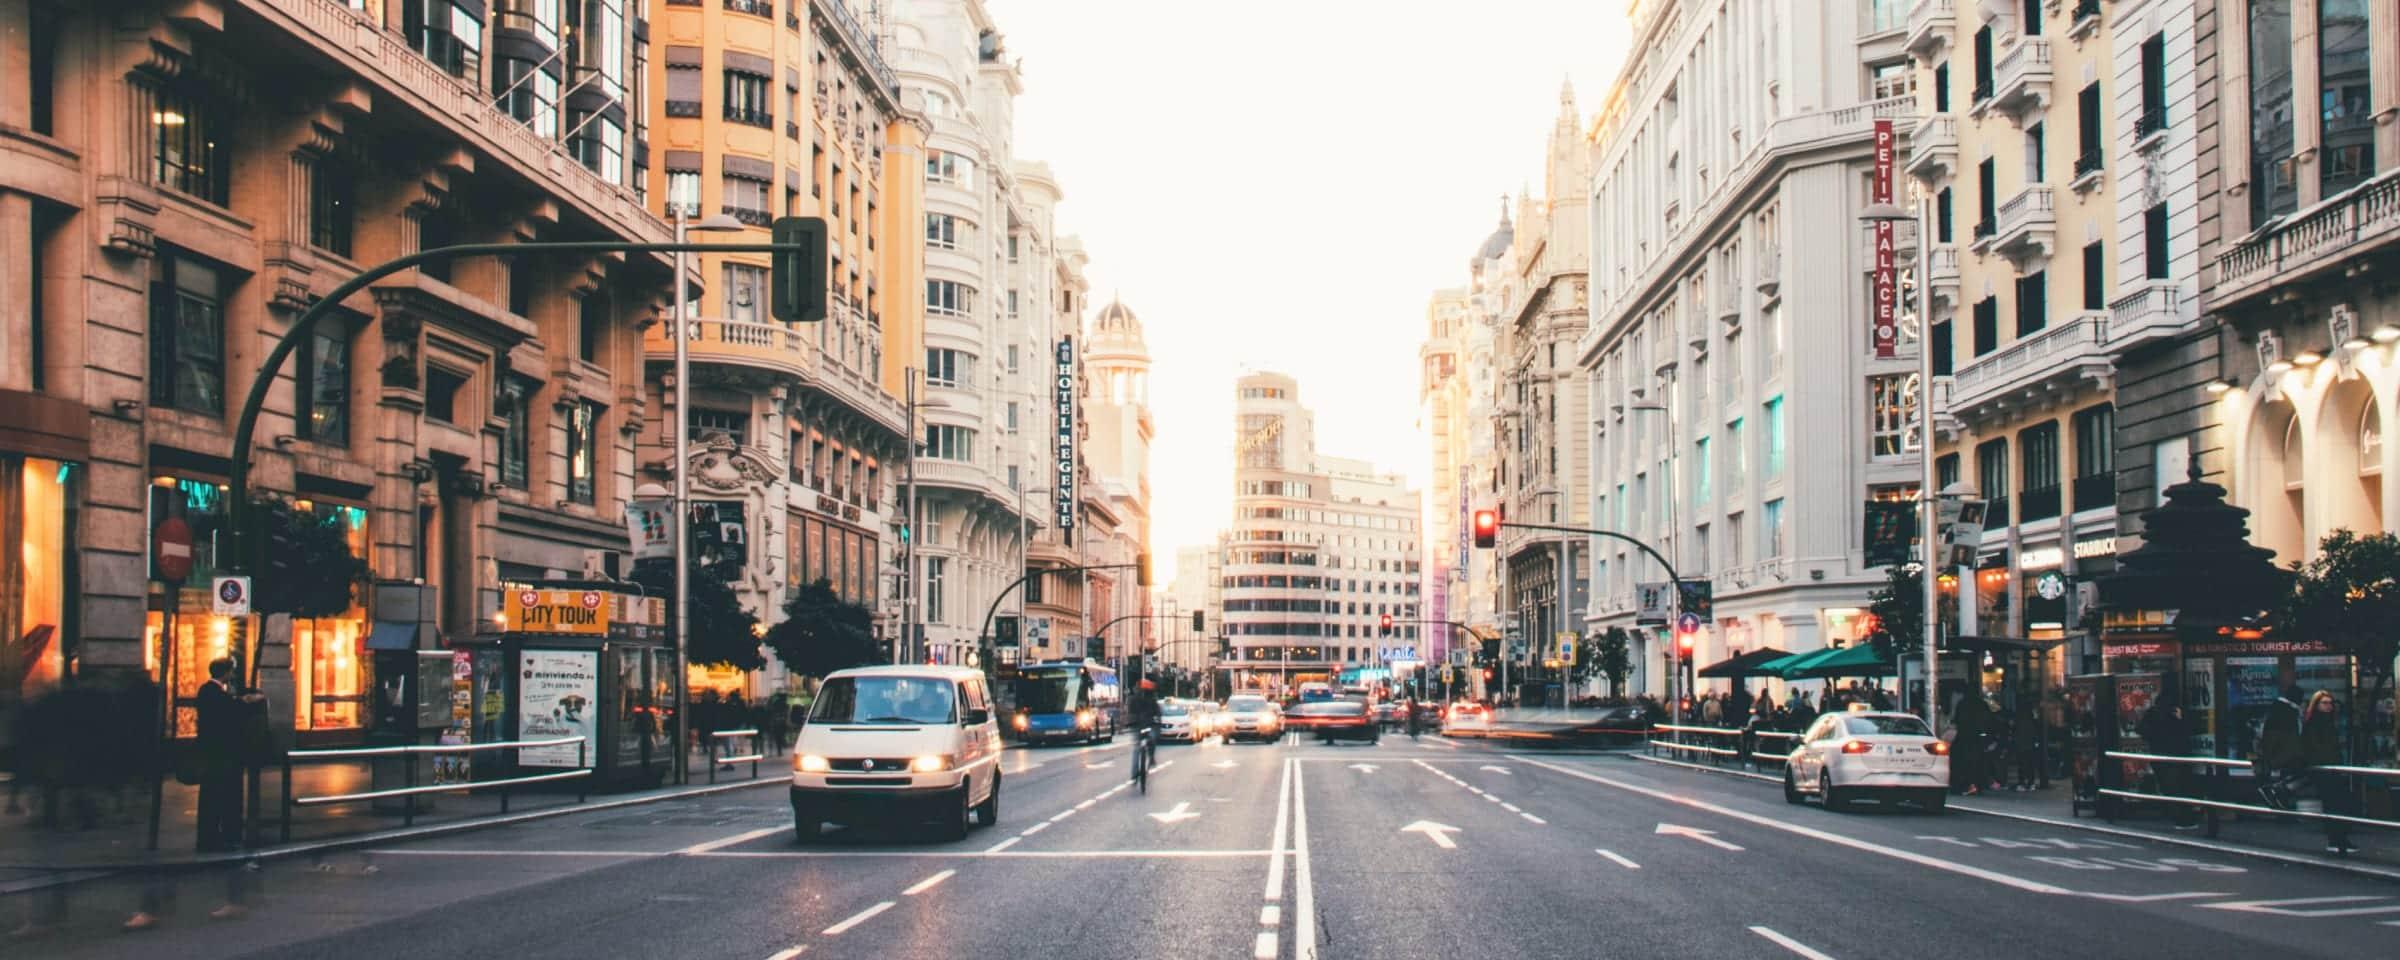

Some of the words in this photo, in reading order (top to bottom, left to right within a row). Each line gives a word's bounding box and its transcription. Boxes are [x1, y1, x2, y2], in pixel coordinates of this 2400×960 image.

[1878, 132, 1889, 204] PETI
[1879, 221, 1890, 318] PALACE
[1059, 364, 1072, 428] HOTEL
[1059, 434, 1072, 527] REGENTE
[522, 606, 554, 624] CITY
[558, 606, 596, 625] TOUR
[2251, 641, 2290, 652] TOURIST
[2023, 856, 2248, 872] BUS
